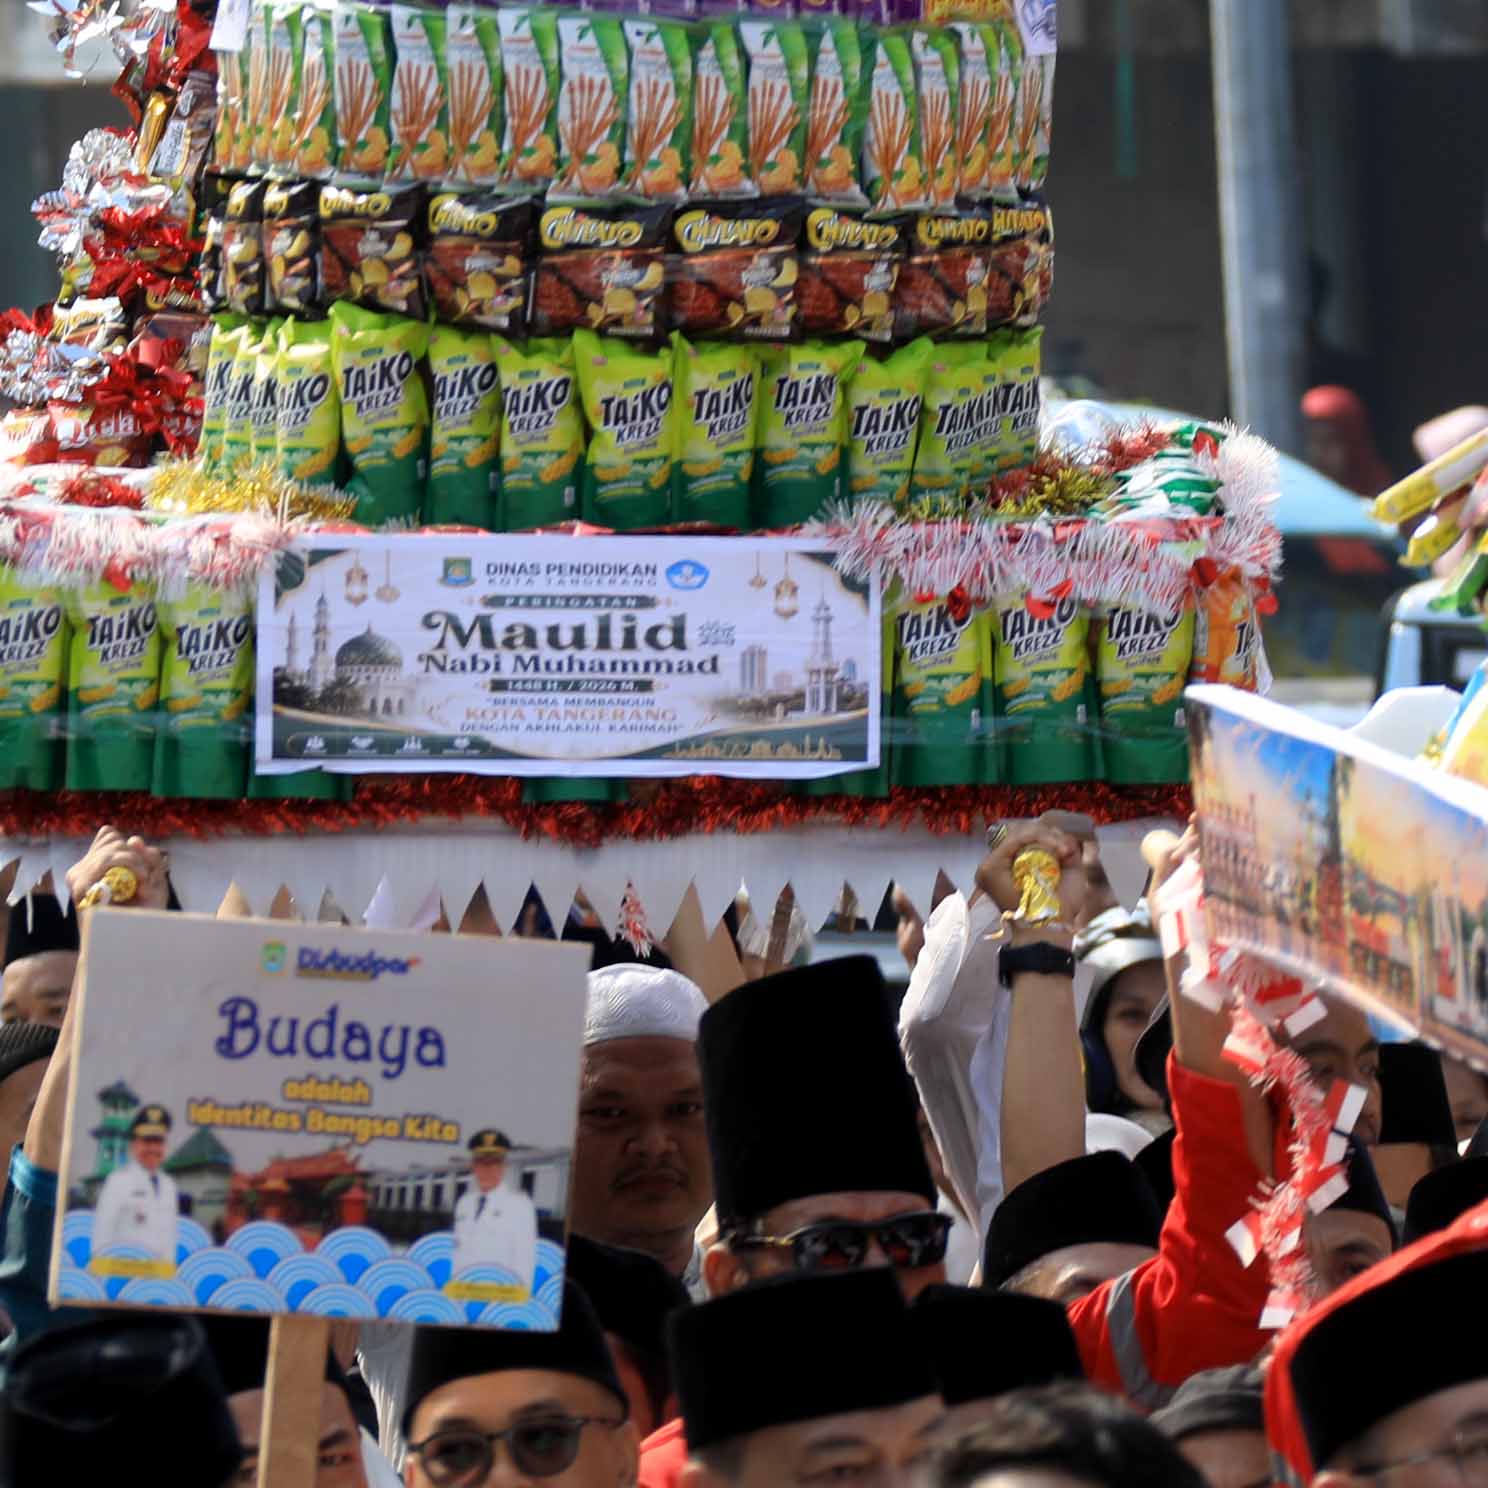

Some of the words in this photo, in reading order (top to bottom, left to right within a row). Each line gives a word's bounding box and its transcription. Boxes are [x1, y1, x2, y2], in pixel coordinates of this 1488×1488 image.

[485, 562, 540, 576] DINAS
[546, 561, 657, 576] PENDIDIKAN
[503, 597, 639, 608] PERINGATAN
[422, 610, 688, 651] Maulid
[417, 653, 502, 674] Nabi
[511, 653, 721, 675] Muhammad
[465, 708, 526, 721] KOTA
[536, 708, 678, 721] TANGERANG
[214, 995, 446, 1080] Budaya
[283, 1076, 371, 1106] adalah
[186, 1100, 301, 1131] Identitas
[306, 1107, 400, 1144] Bangsa
[404, 1113, 459, 1143] Kita
